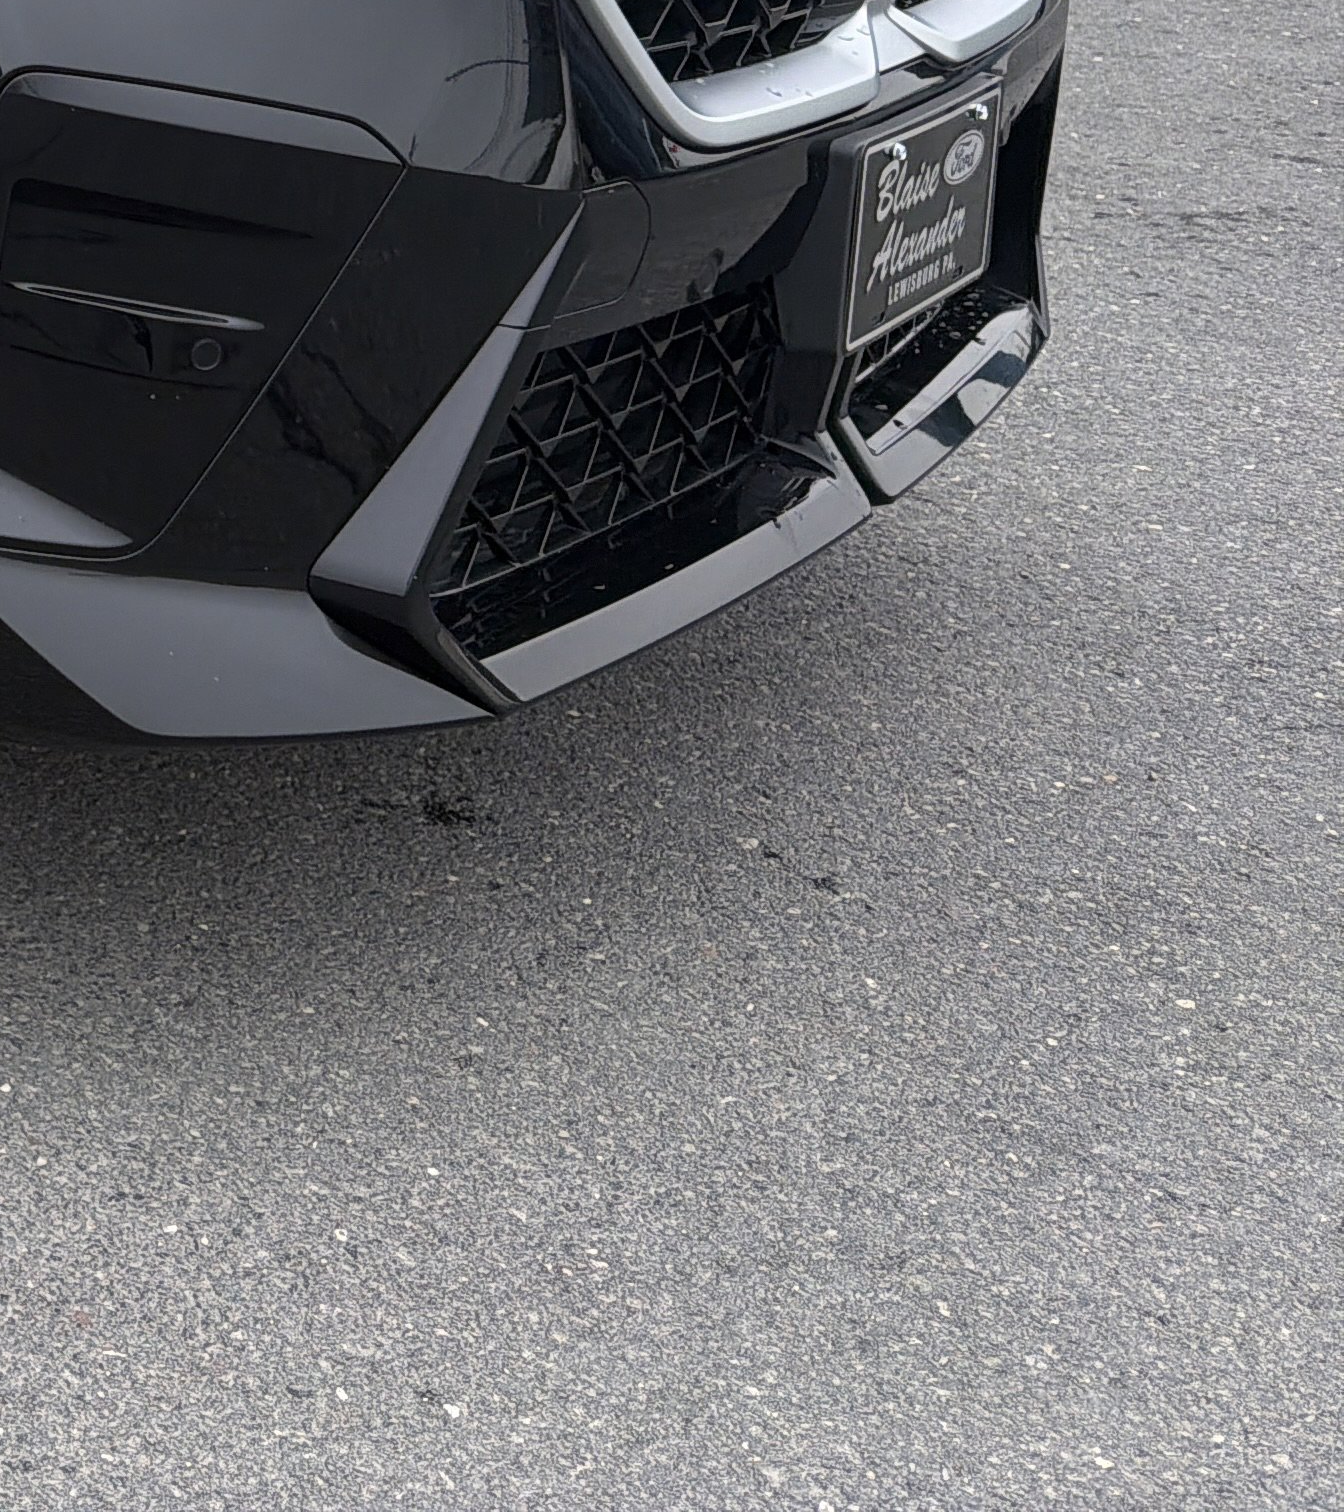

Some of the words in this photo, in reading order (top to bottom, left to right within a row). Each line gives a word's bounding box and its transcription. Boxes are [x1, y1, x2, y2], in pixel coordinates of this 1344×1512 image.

[876, 159, 940, 223] Blaise
[866, 194, 967, 295] Alexander
[887, 262, 940, 306] LEWISBURG
